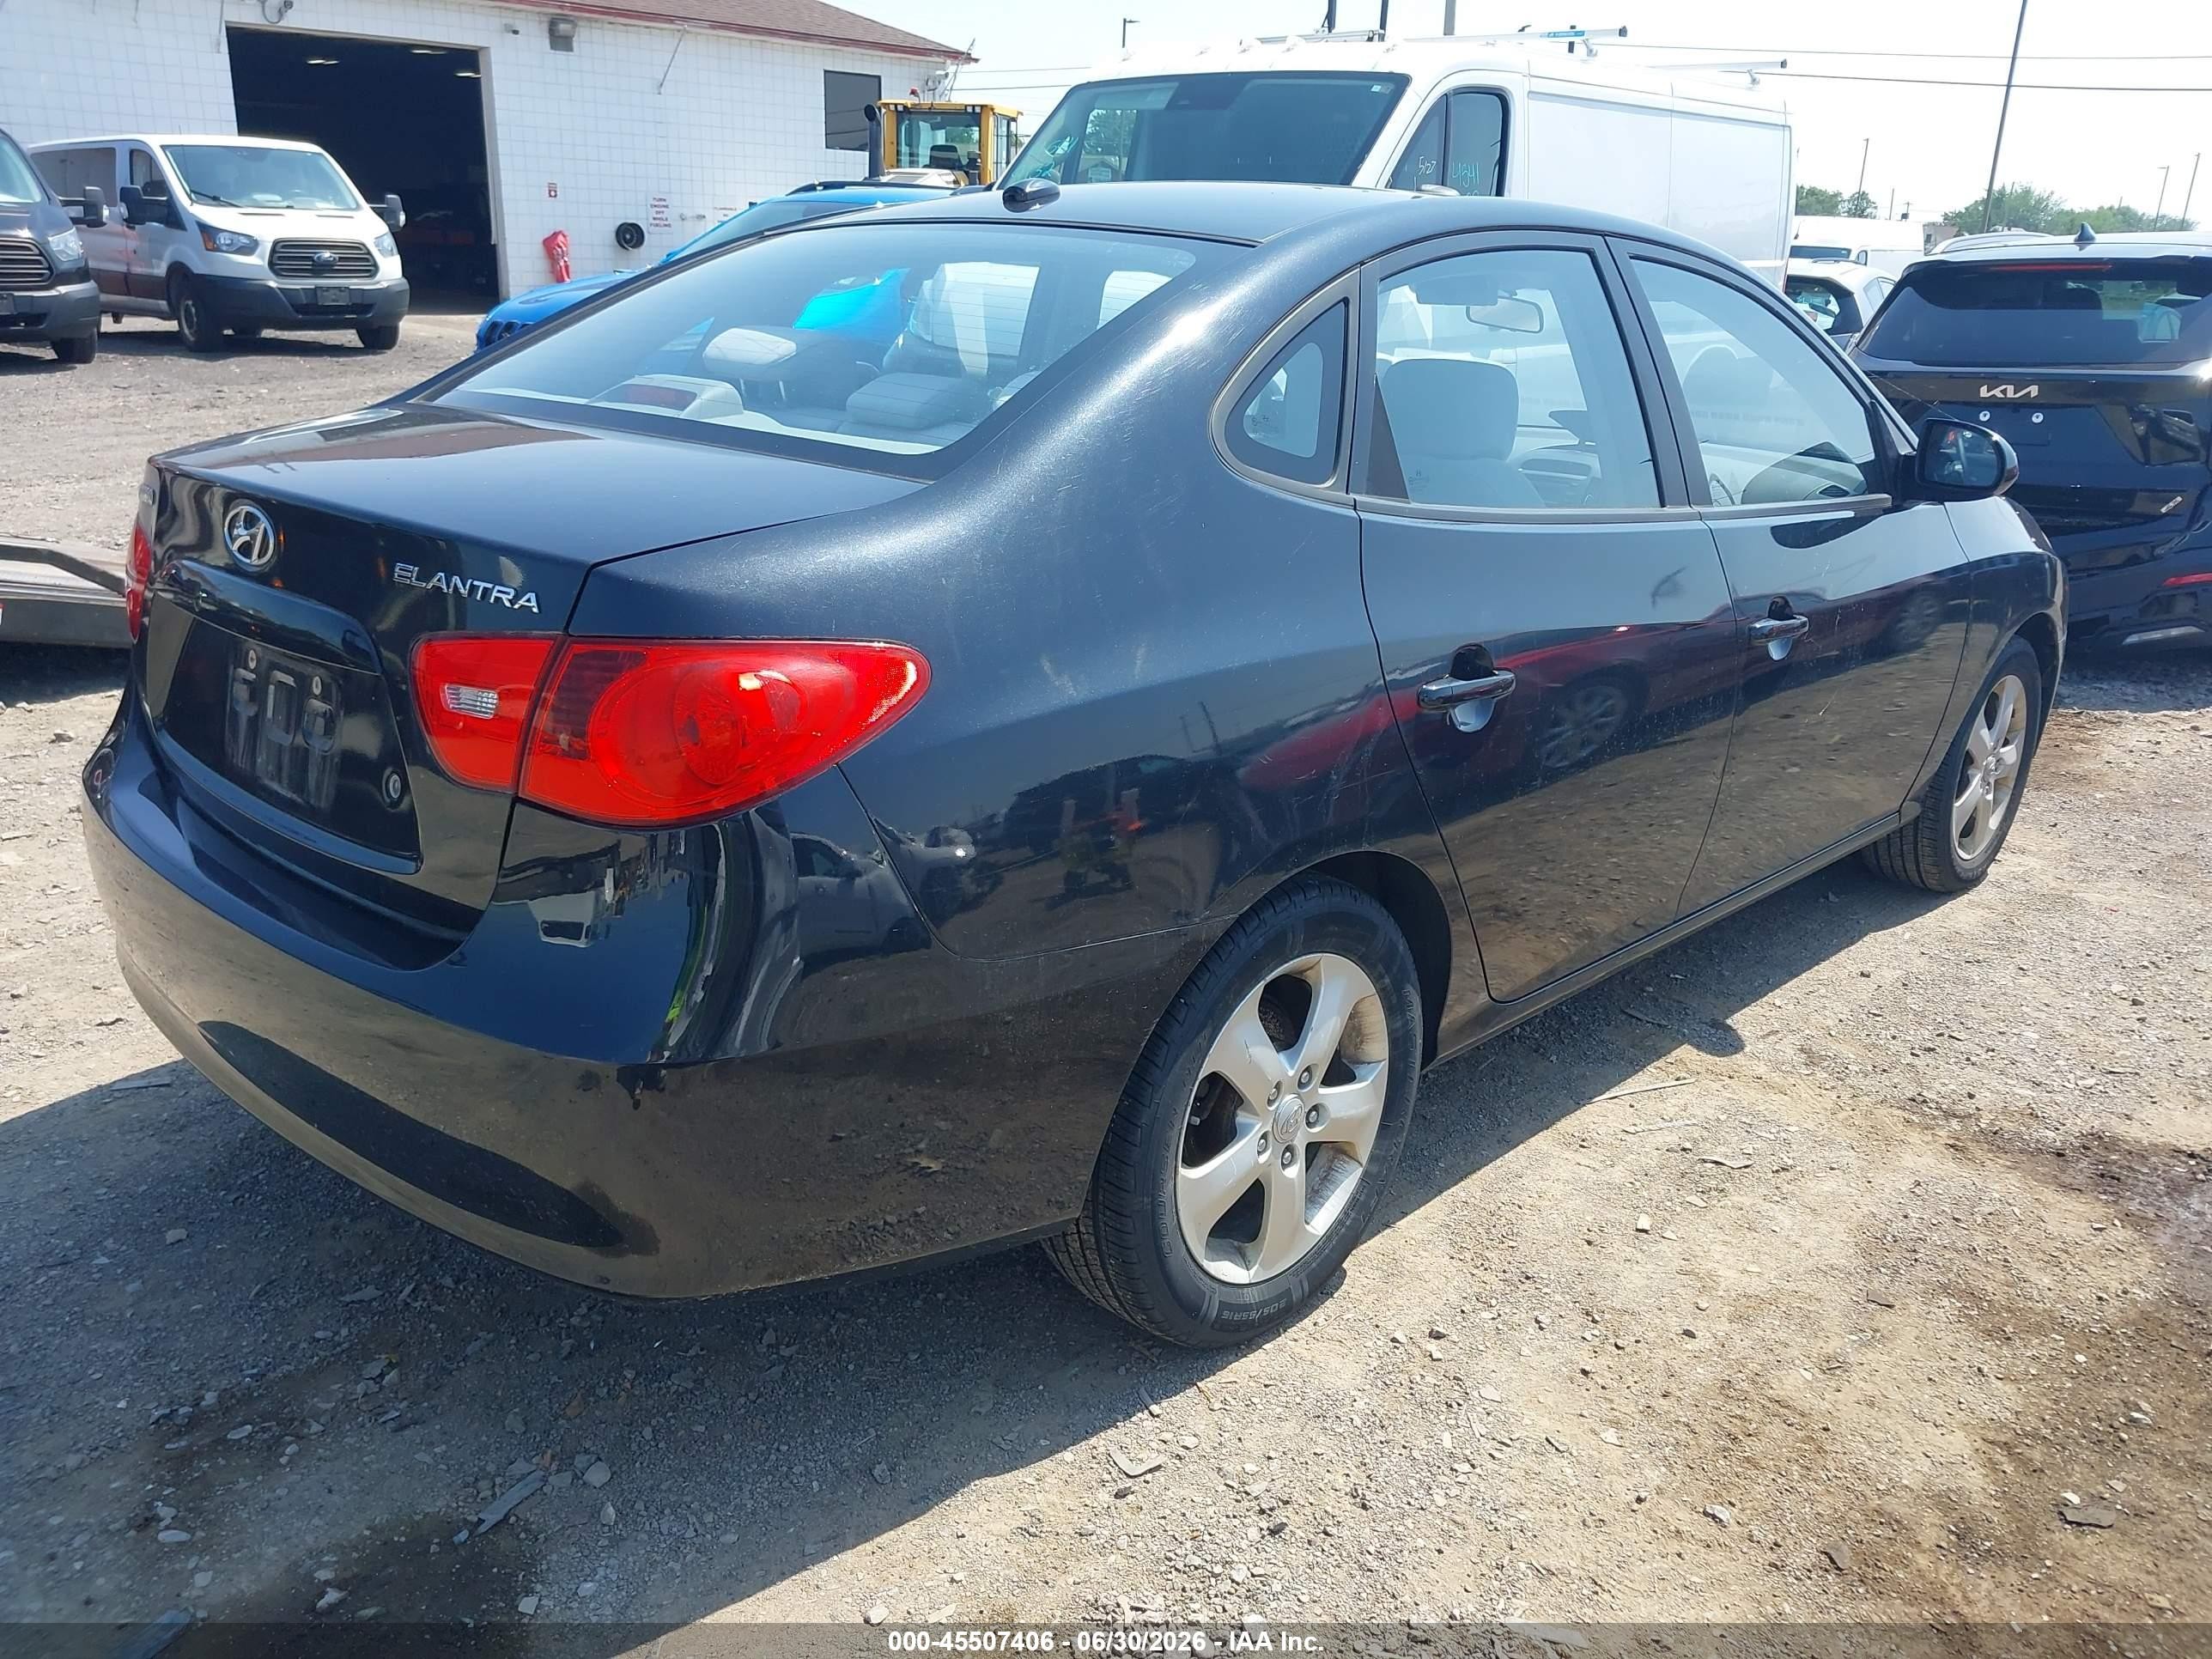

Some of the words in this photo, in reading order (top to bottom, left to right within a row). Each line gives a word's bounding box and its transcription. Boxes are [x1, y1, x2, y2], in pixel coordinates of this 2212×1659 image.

[1978, 384, 2040, 398] KIA
[392, 562, 540, 614] ELANTRA
[1220, 1297, 1288, 1321] 205/55R16
